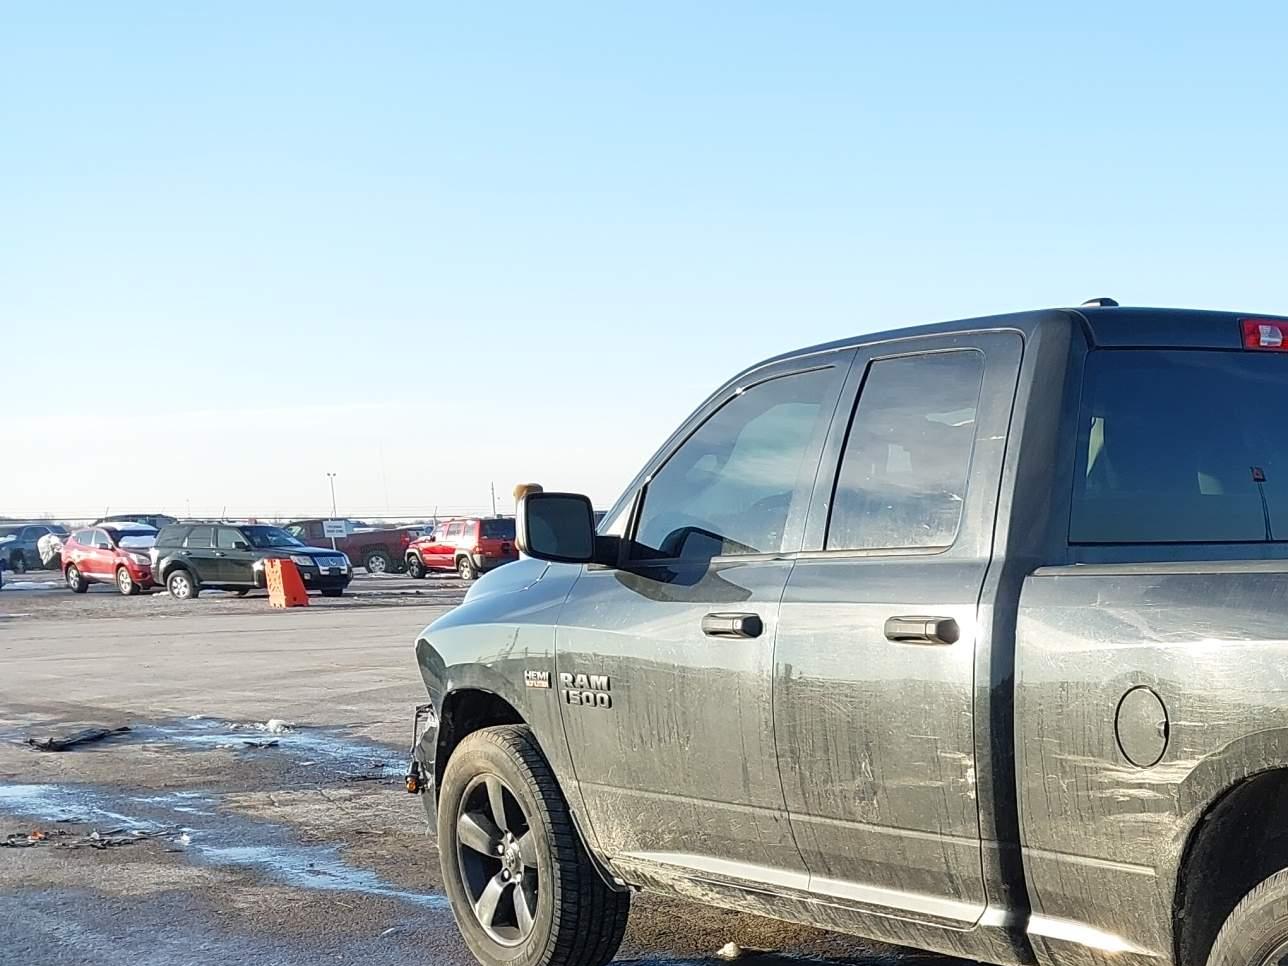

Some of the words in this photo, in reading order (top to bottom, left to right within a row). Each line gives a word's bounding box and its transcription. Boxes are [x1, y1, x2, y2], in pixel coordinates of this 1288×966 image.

[525, 670, 549, 681] HEMI
[560, 672, 609, 691] RAM
[562, 690, 611, 708] 1500
